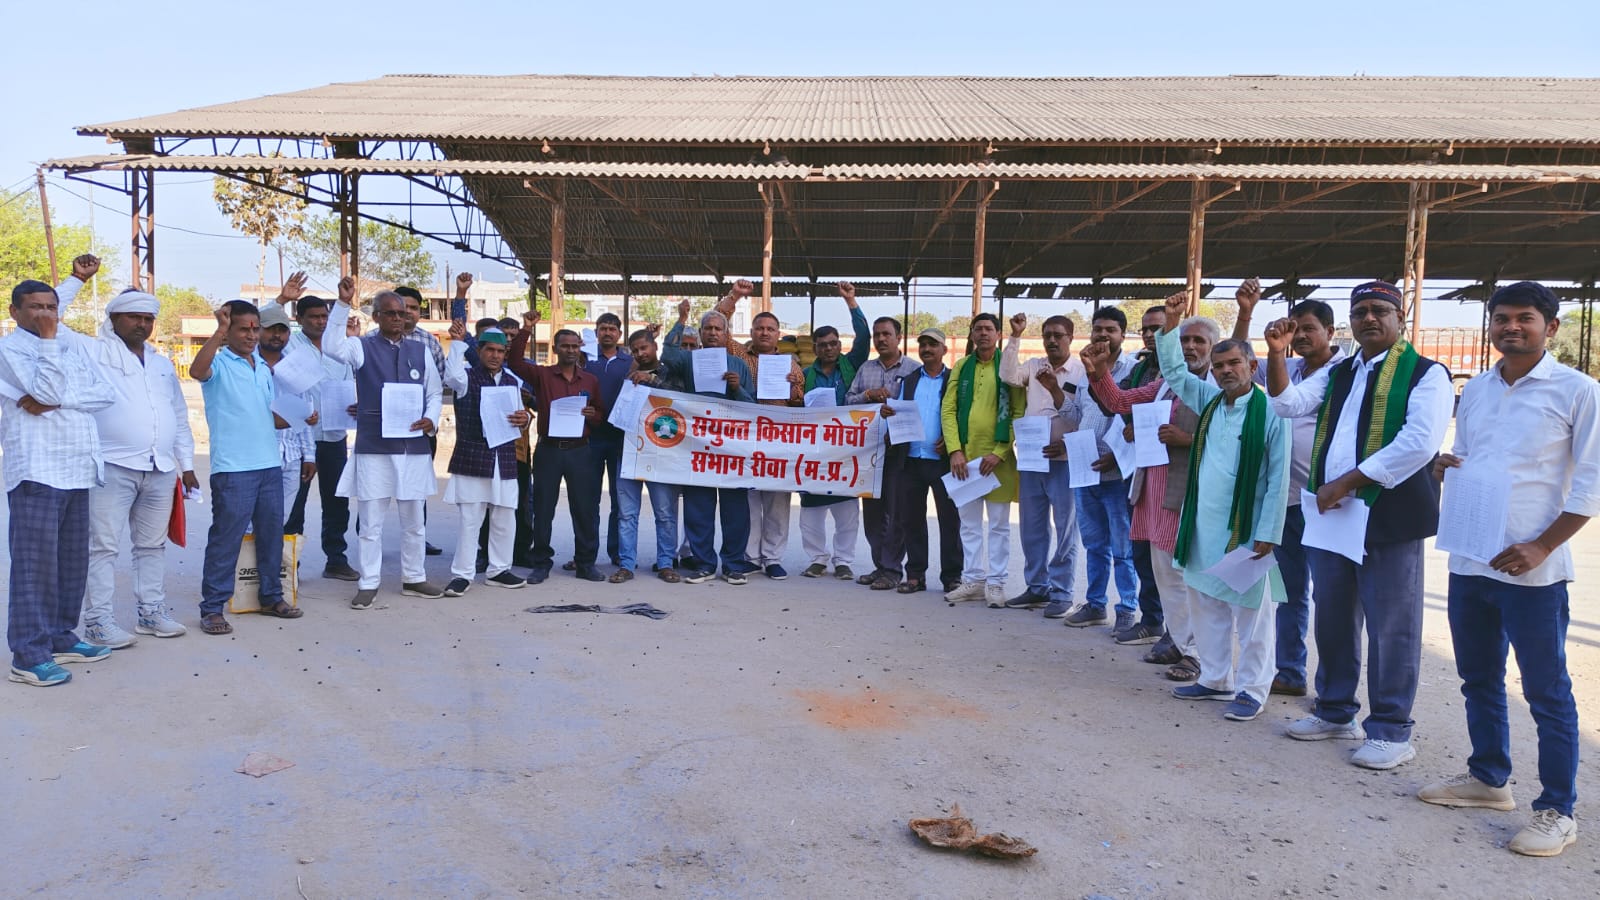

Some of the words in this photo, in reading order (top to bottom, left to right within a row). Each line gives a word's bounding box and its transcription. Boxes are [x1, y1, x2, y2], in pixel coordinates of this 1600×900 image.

[691, 410, 751, 447] संयुक्त
[756, 415, 818, 446] किसान
[824, 418, 868, 447] मोर्चा
[691, 445, 746, 476] संभाग
[751, 451, 788, 479] रीवा
[795, 454, 859, 487] (म.प्र.)
